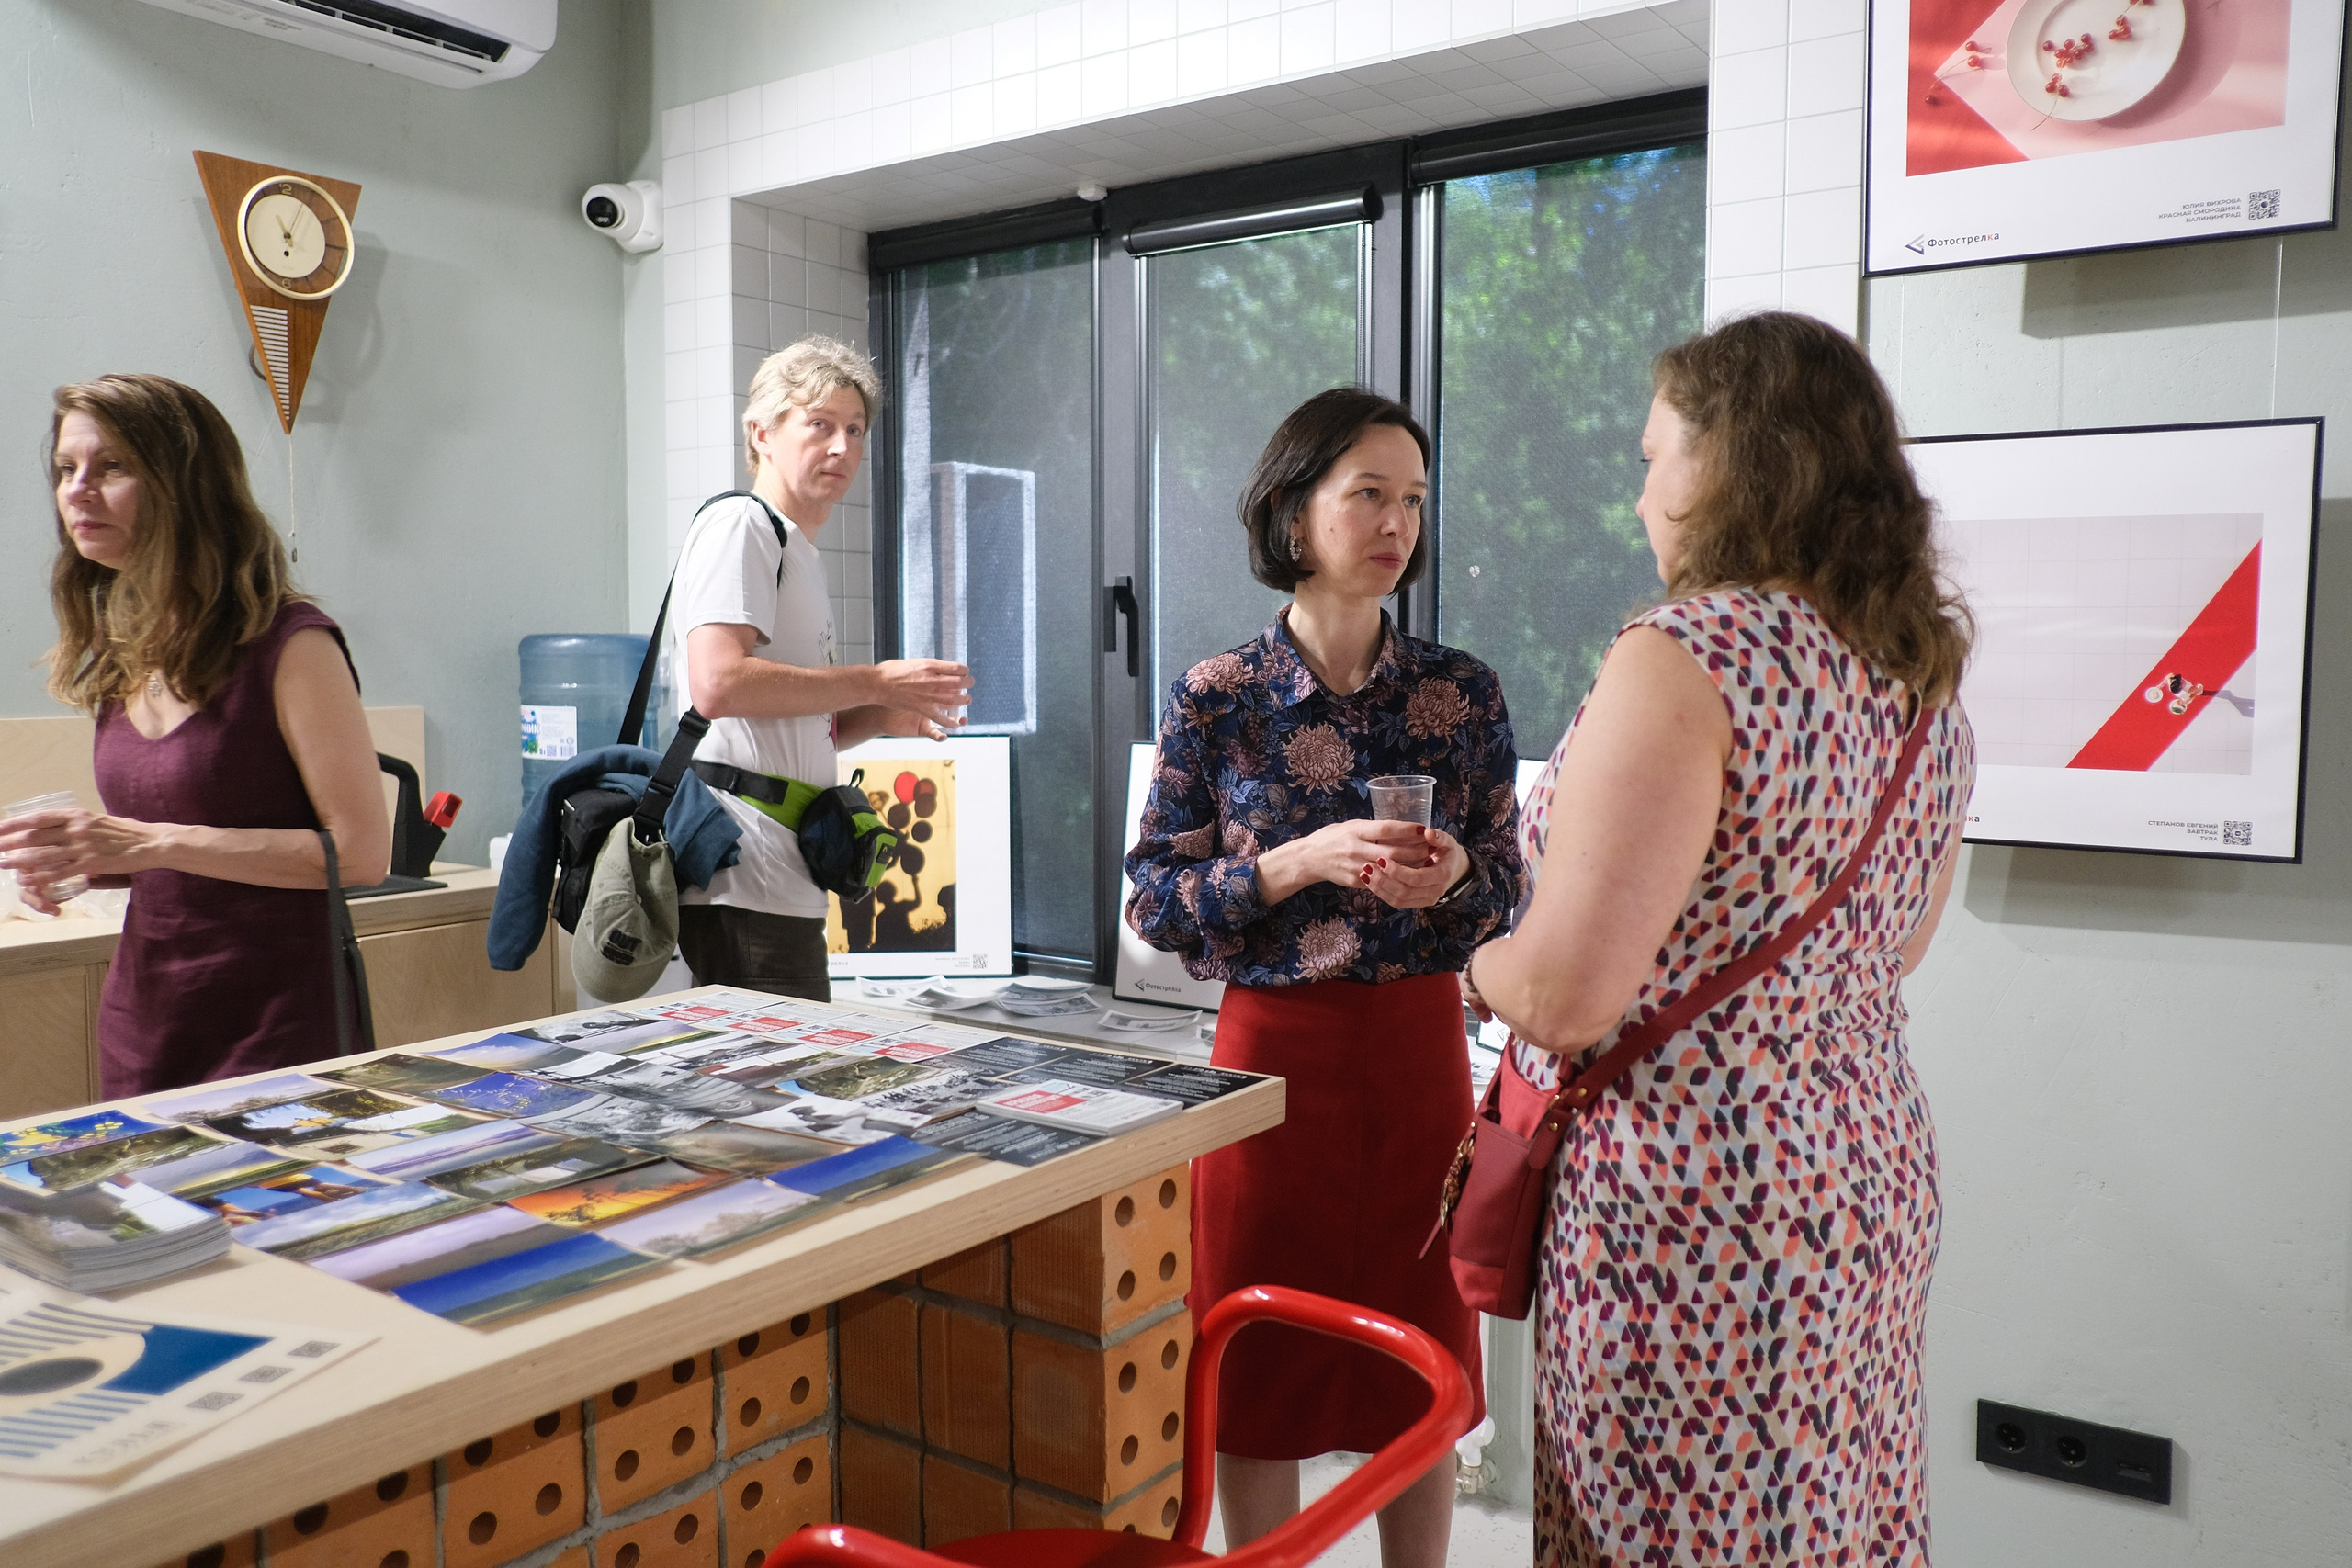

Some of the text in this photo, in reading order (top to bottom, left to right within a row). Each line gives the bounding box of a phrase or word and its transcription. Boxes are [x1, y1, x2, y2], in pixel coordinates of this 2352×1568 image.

[279, 183, 292, 195] 12
[2207, 197, 2242, 206] ВИХРОВА
[2158, 205, 2242, 220] КРАСНАЯ СМОРОДИНА
[2186, 211, 2242, 223] КАЛИНИНГРАД
[1928, 232, 2000, 247] Фотострелка
[1145, 982, 1182, 992] Фотострелка
